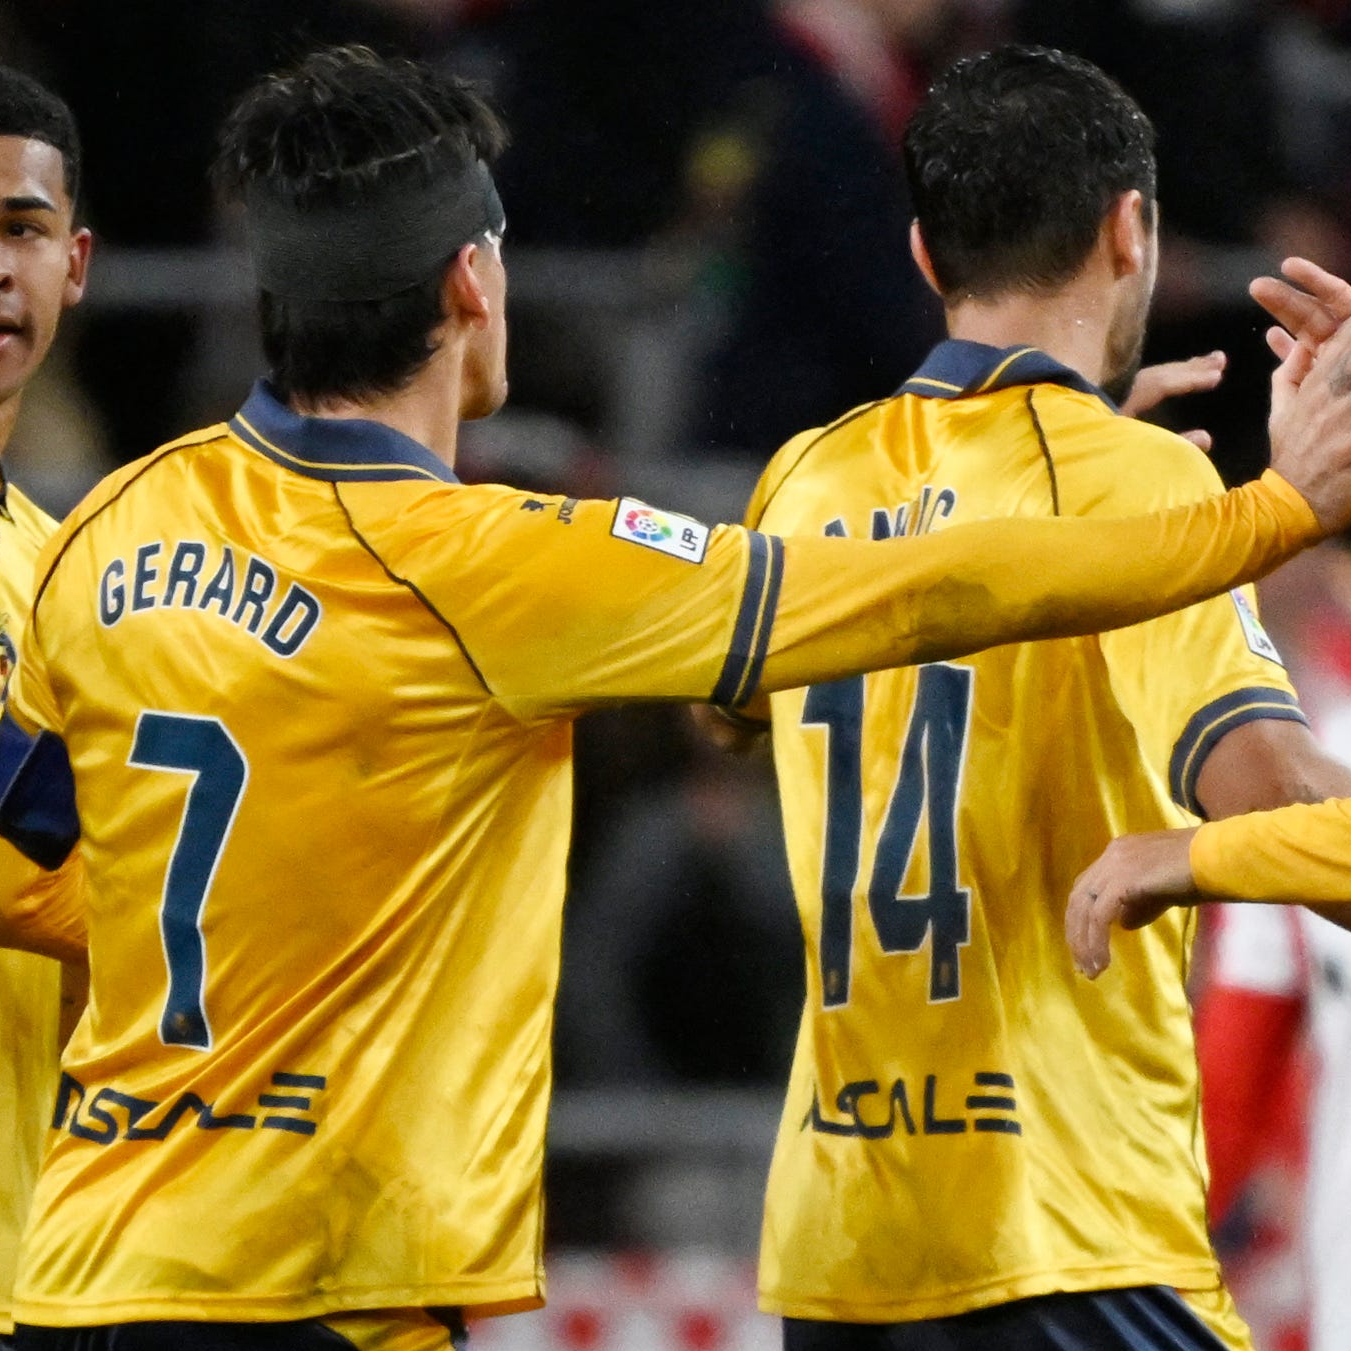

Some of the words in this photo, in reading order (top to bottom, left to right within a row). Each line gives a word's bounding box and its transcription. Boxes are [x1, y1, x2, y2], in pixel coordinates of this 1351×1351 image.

[100, 541, 323, 659] GERARD
[126, 709, 249, 1052] 7
[801, 662, 974, 1012] 14
